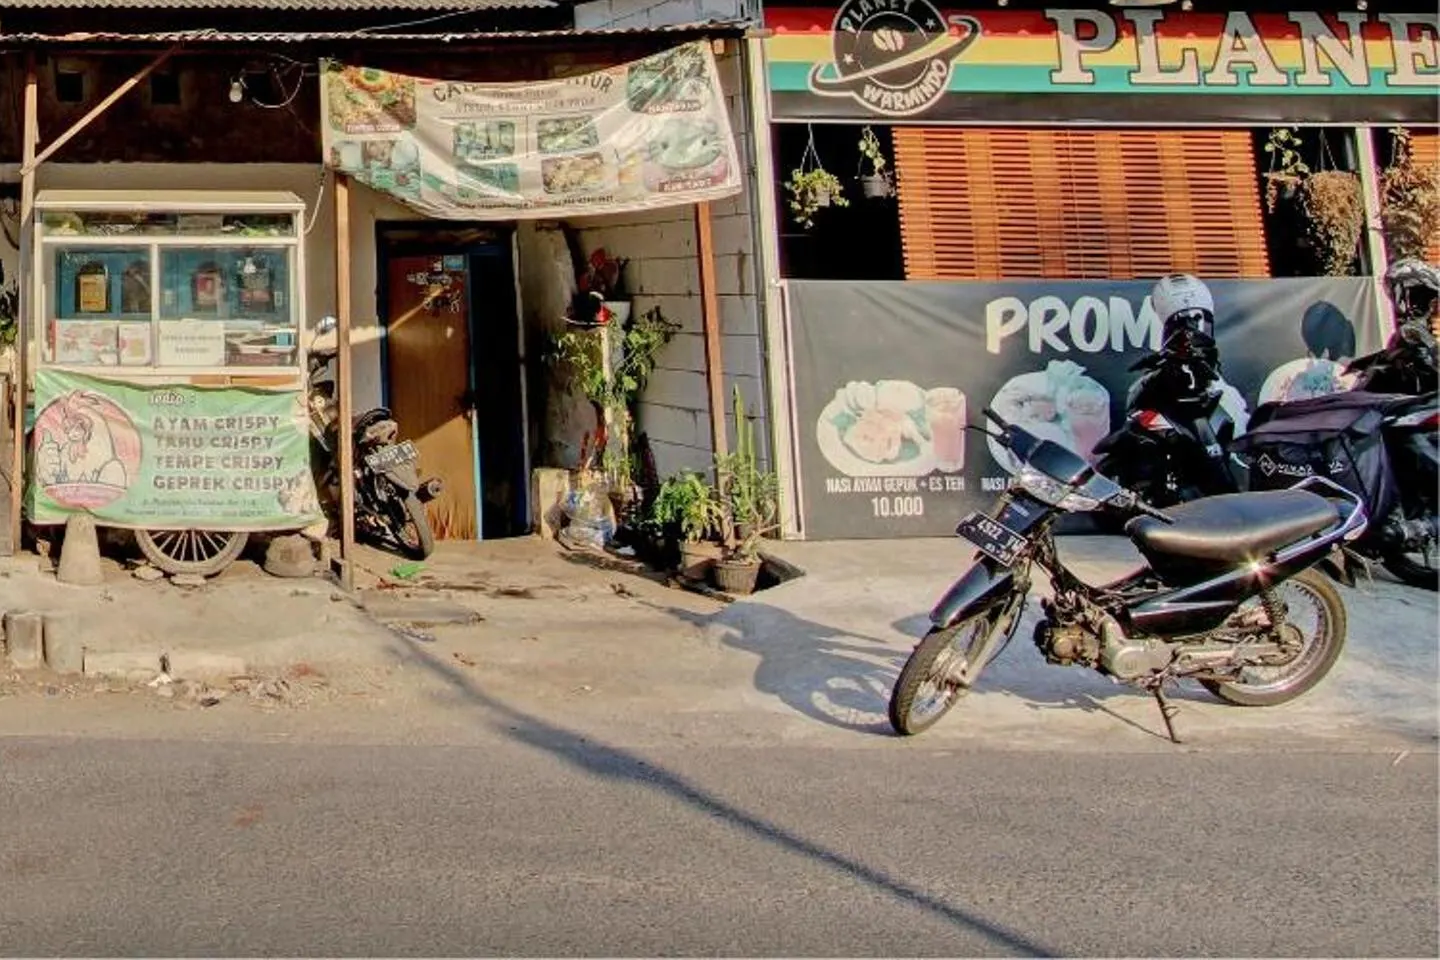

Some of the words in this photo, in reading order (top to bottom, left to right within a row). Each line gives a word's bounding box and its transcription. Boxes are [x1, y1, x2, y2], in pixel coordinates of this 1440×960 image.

[1045, 8, 1440, 87] PLANE
[863, 58, 948, 111] WARMINDO
[986, 295, 1162, 355] PROM
[153, 416, 208, 431] AYAM
[214, 415, 280, 431] CRISPY
[154, 433, 204, 449] TAHU
[211, 435, 273, 450] CRISPY
[154, 455, 215, 469] TEMPE
[221, 455, 284, 470] CRISPY
[153, 475, 225, 490] GEPREK
[232, 475, 295, 491] CRISPY
[826, 477, 852, 493] NASI
[928, 476, 944, 490] ES
[944, 476, 965, 491] TEH
[981, 477, 1006, 492] NASI
[871, 496, 924, 517] 10.000
